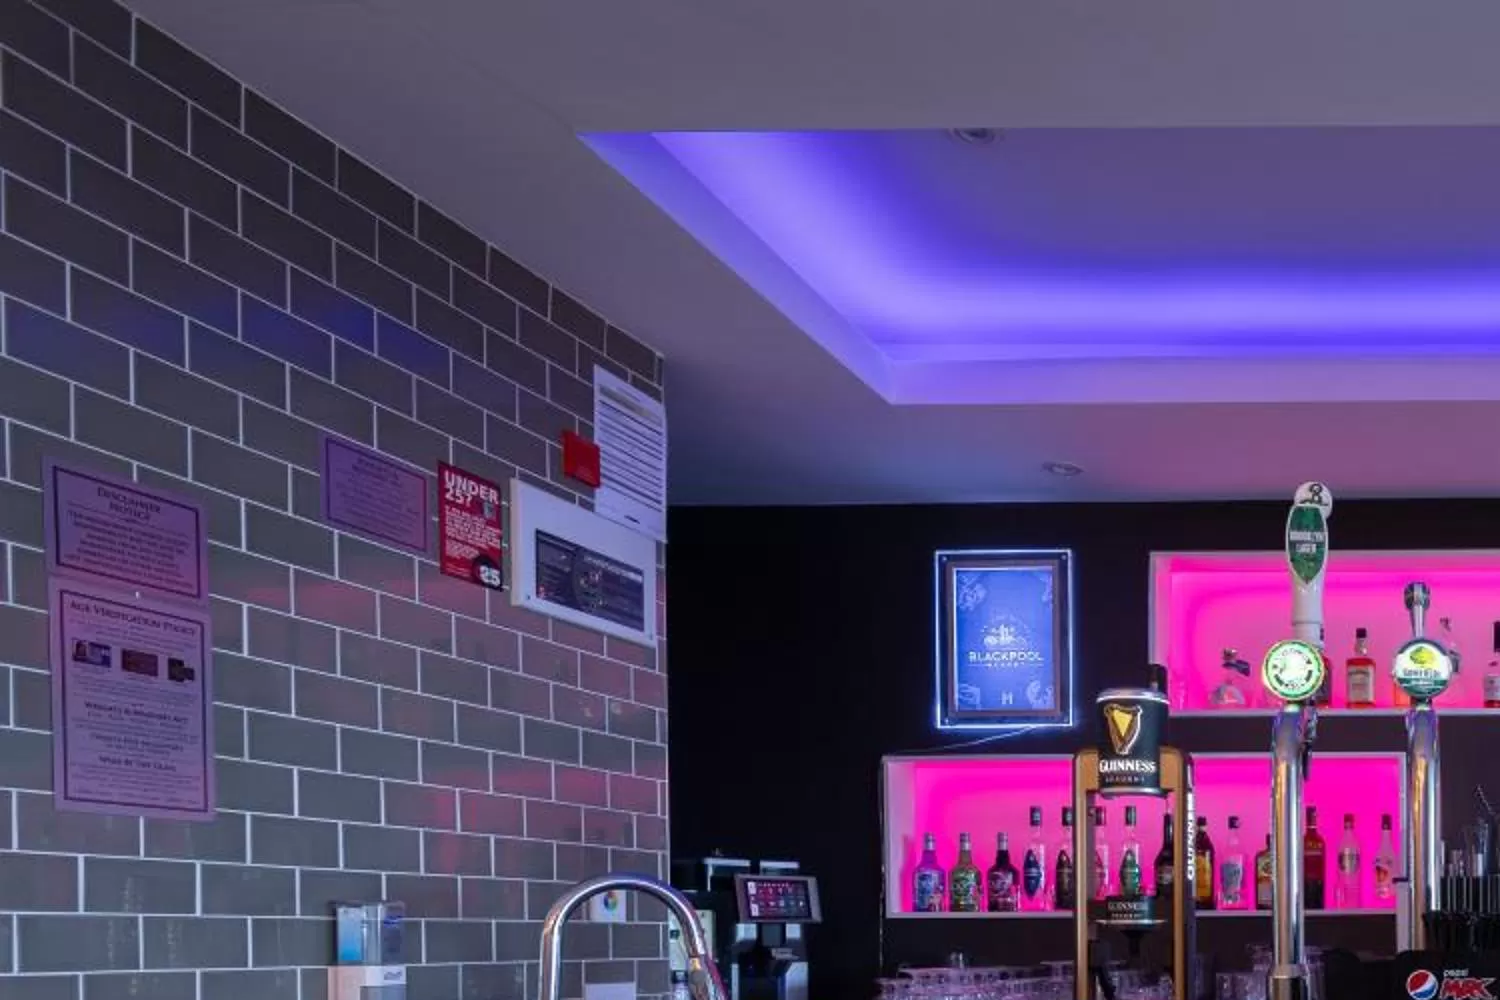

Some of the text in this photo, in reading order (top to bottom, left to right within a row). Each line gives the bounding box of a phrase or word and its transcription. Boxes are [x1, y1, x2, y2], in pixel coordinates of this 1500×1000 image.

[444, 470, 499, 504] UNDER
[445, 488, 472, 507] 25?
[479, 564, 501, 587] 25
[968, 651, 1044, 662] BLACKPOOL
[1099, 759, 1156, 773] GUINNESS
[1440, 977, 1498, 1000] MAX
